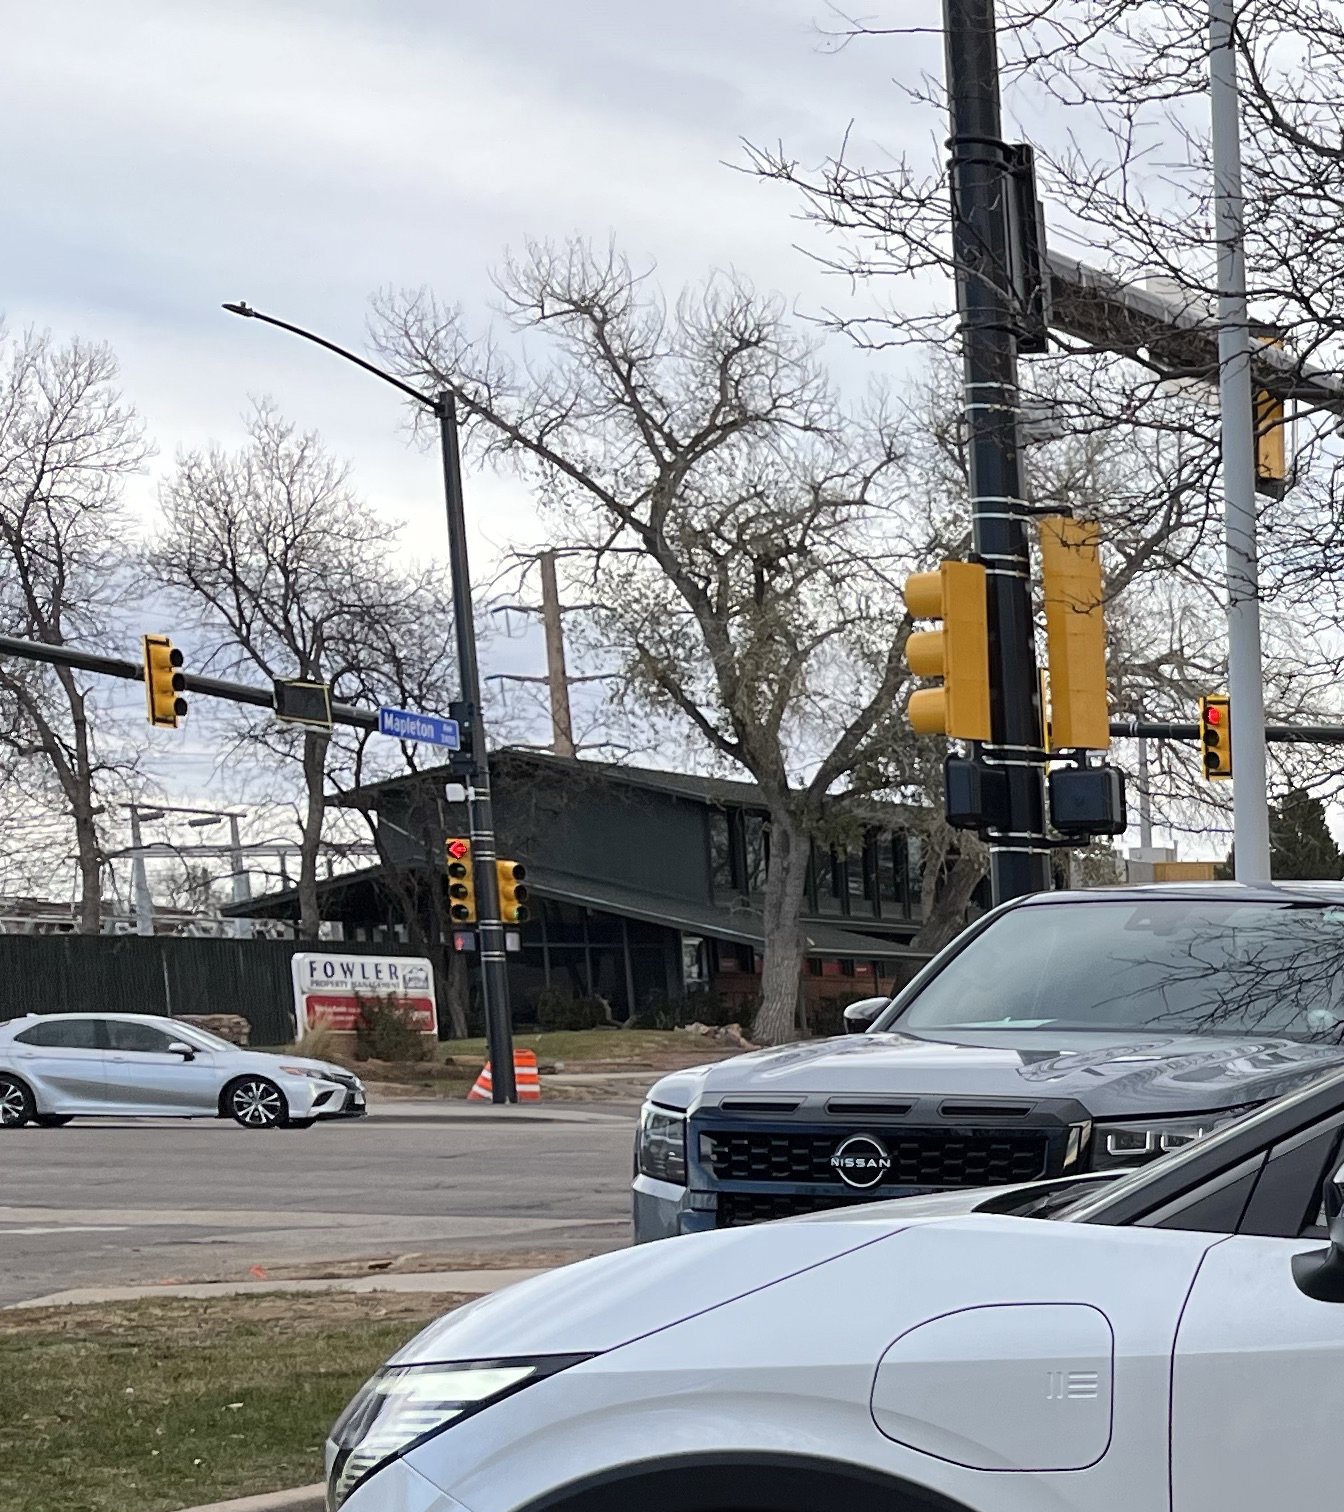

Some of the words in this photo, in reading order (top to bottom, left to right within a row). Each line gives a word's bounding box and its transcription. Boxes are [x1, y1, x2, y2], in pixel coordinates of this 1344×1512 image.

[384, 711, 435, 739] Mapleton
[309, 960, 399, 980] FOWLER
[310, 980, 348, 988] PROPERTY
[830, 1157, 891, 1168] NISSAN
